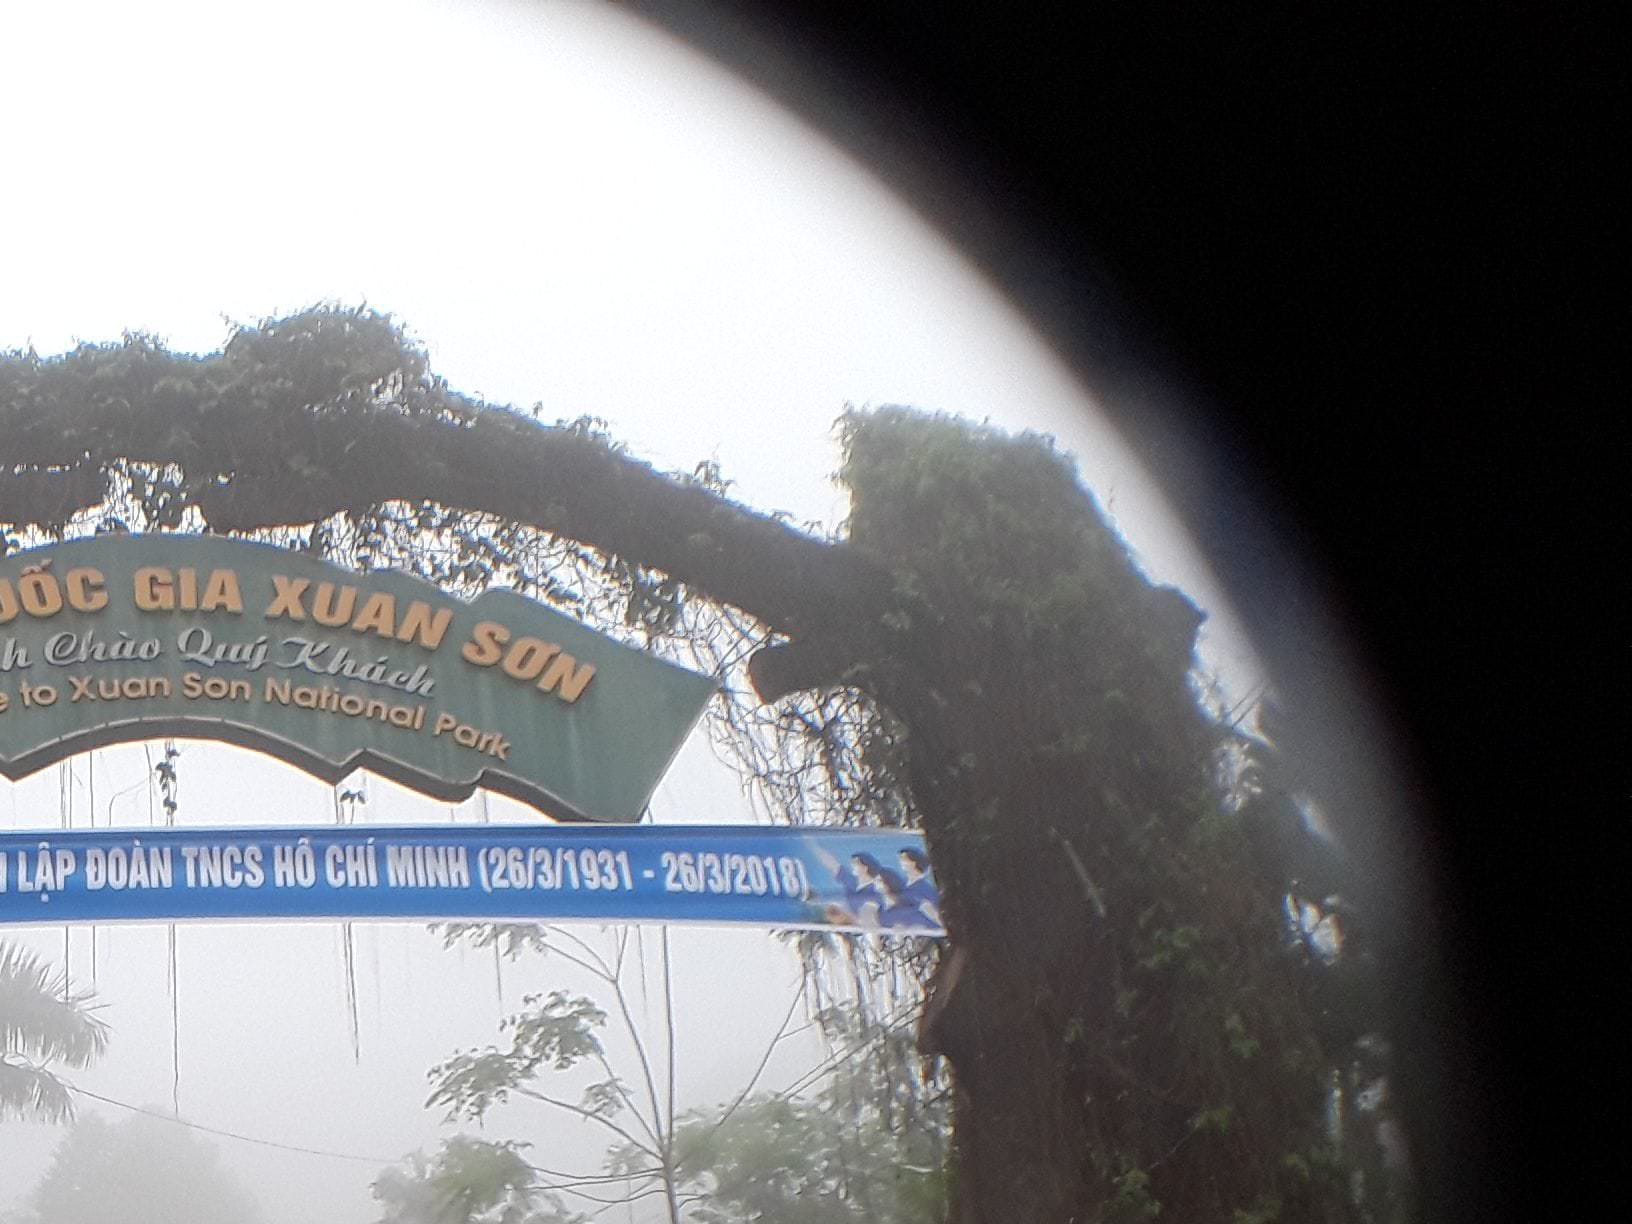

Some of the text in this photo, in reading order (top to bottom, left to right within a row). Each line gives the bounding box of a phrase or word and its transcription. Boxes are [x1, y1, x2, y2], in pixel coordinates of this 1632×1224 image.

[43, 628, 162, 664] Chào
[177, 625, 270, 666] Quý
[274, 635, 437, 699] Khách
[134, 567, 244, 613] GIA
[264, 573, 453, 651] XUAN
[463, 620, 598, 704] SƠN
[20, 678, 58, 708] to
[69, 676, 170, 702] Xuan
[182, 672, 252, 702] Son
[264, 677, 424, 731] National
[433, 711, 512, 762] Park
[17, 841, 77, 903] LẬP
[85, 839, 171, 891] ĐOÀN
[180, 846, 265, 889] TNCS
[274, 837, 316, 889] HỒ
[325, 837, 378, 889] CHÍ
[385, 845, 470, 889] MINH
[477, 846, 633, 893] (26/3/1931
[642, 868, 655, 878] -
[660, 851, 811, 902] 26/3/2018)
